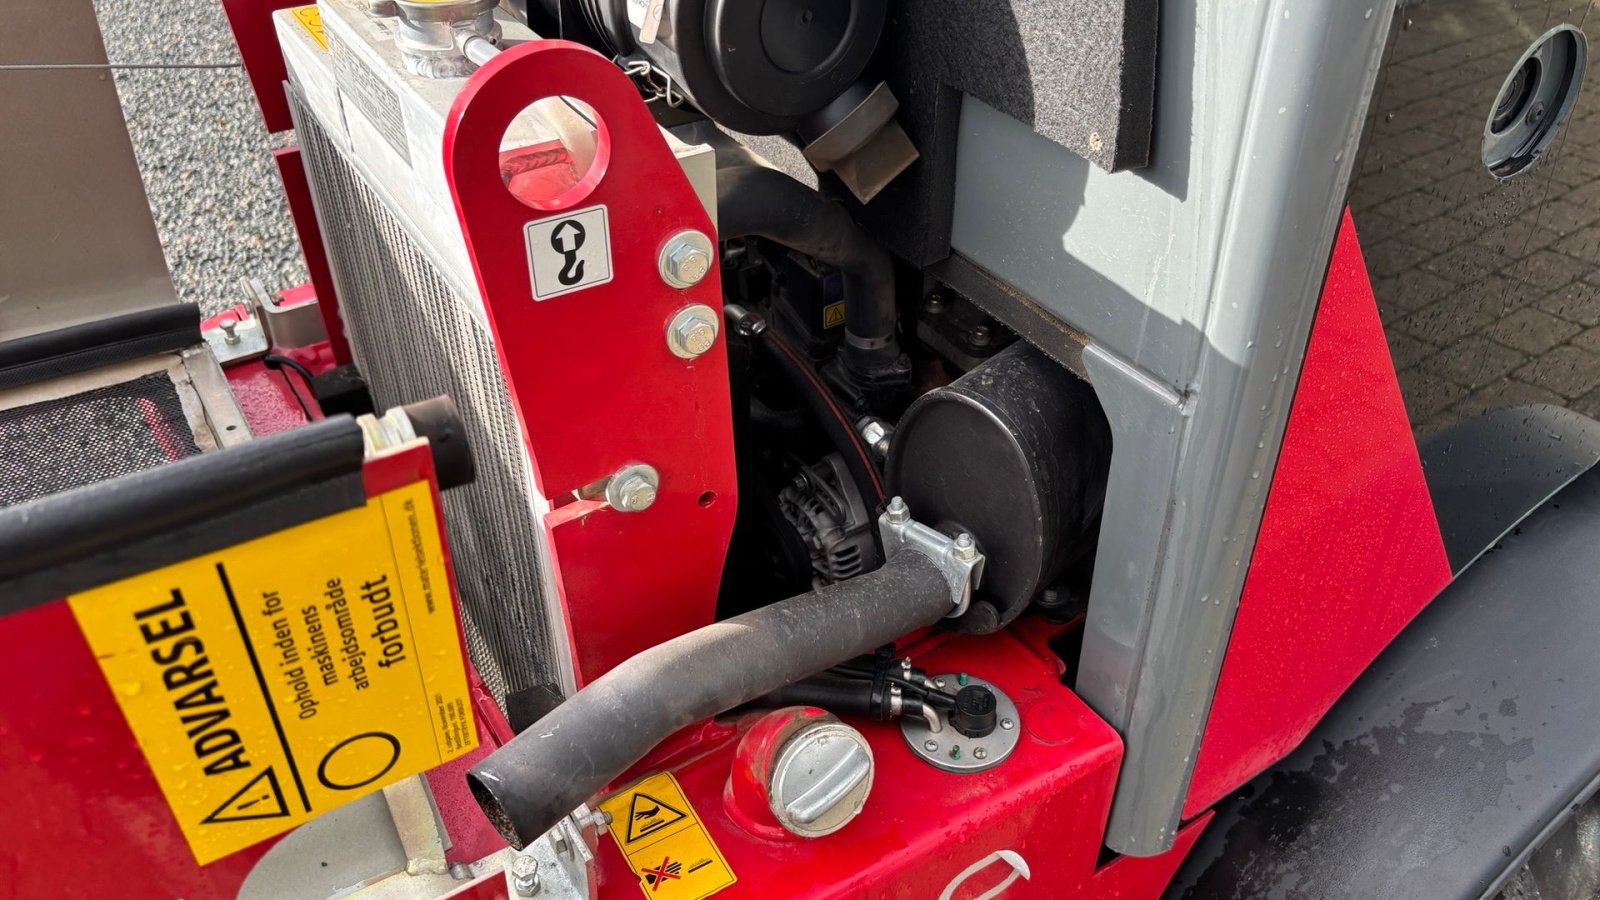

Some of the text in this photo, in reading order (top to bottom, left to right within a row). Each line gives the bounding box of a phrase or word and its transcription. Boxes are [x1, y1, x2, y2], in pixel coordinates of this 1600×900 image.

[262, 591, 318, 719] Ophold inden for
[301, 605, 337, 686] maskinens
[324, 577, 369, 690] arbejdsområde
[360, 574, 405, 667] forbudt
[134, 588, 250, 775] ADVARSEL
